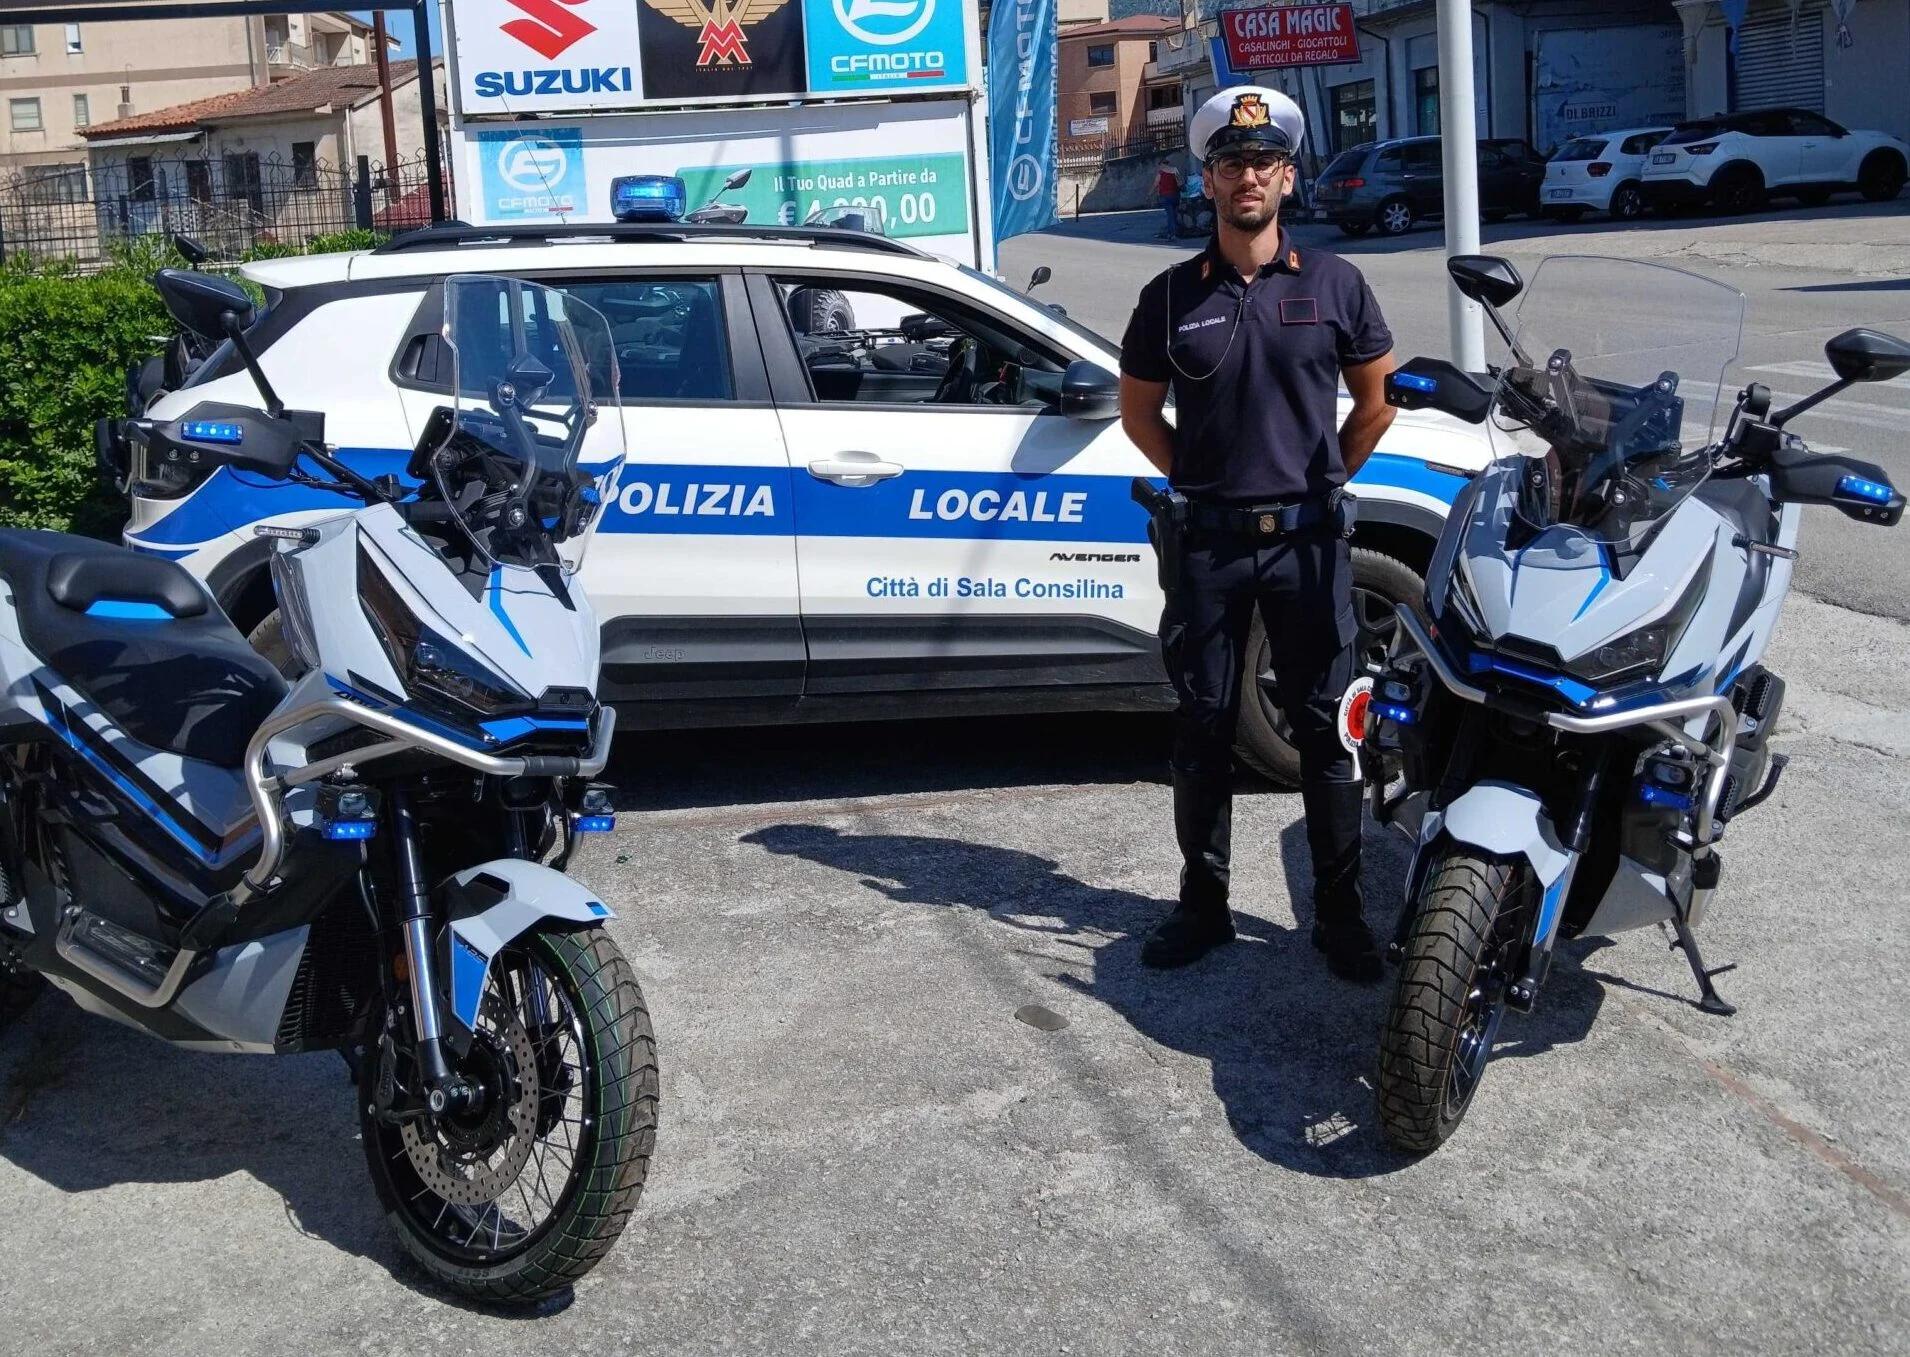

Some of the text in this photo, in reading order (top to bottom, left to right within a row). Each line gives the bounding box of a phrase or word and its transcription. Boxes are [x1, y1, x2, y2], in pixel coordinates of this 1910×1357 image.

[1234, 7, 1341, 39] CASA MAGIC
[1239, 39, 1290, 53] CASALINGHI
[1297, 36, 1347, 48] GIOCATTOLI
[831, 51, 945, 73] CFMOTO
[1249, 49, 1338, 65] ARTICOLI DA REGALO
[475, 67, 632, 98] SUZUKI
[773, 168, 937, 192] Il Tuo Quad a Partire da
[1178, 321, 1200, 333] POLIZIA
[598, 481, 1088, 523] POLIZIA LOCALE
[1050, 553, 1141, 562] AVENGER
[867, 577, 1124, 599] Città di Sala Consilina
[642, 646, 689, 662] Jeep
